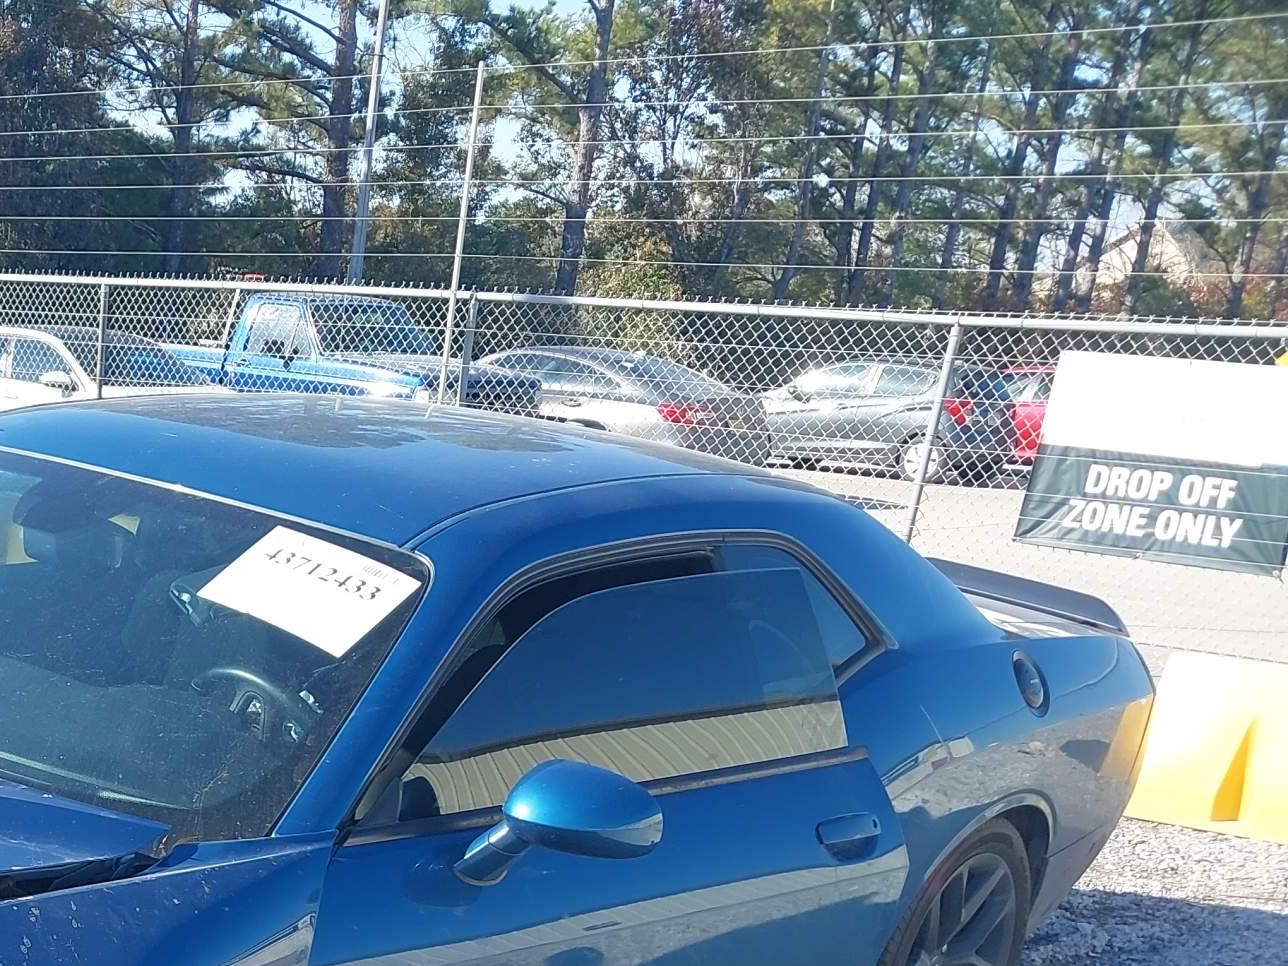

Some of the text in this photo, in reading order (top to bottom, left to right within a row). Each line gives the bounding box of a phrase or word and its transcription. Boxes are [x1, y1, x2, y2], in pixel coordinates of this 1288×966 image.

[1085, 464, 1238, 510] DROP OFF
[1062, 498, 1243, 548] ZONE ONLY
[264, 548, 382, 601] 43712433
